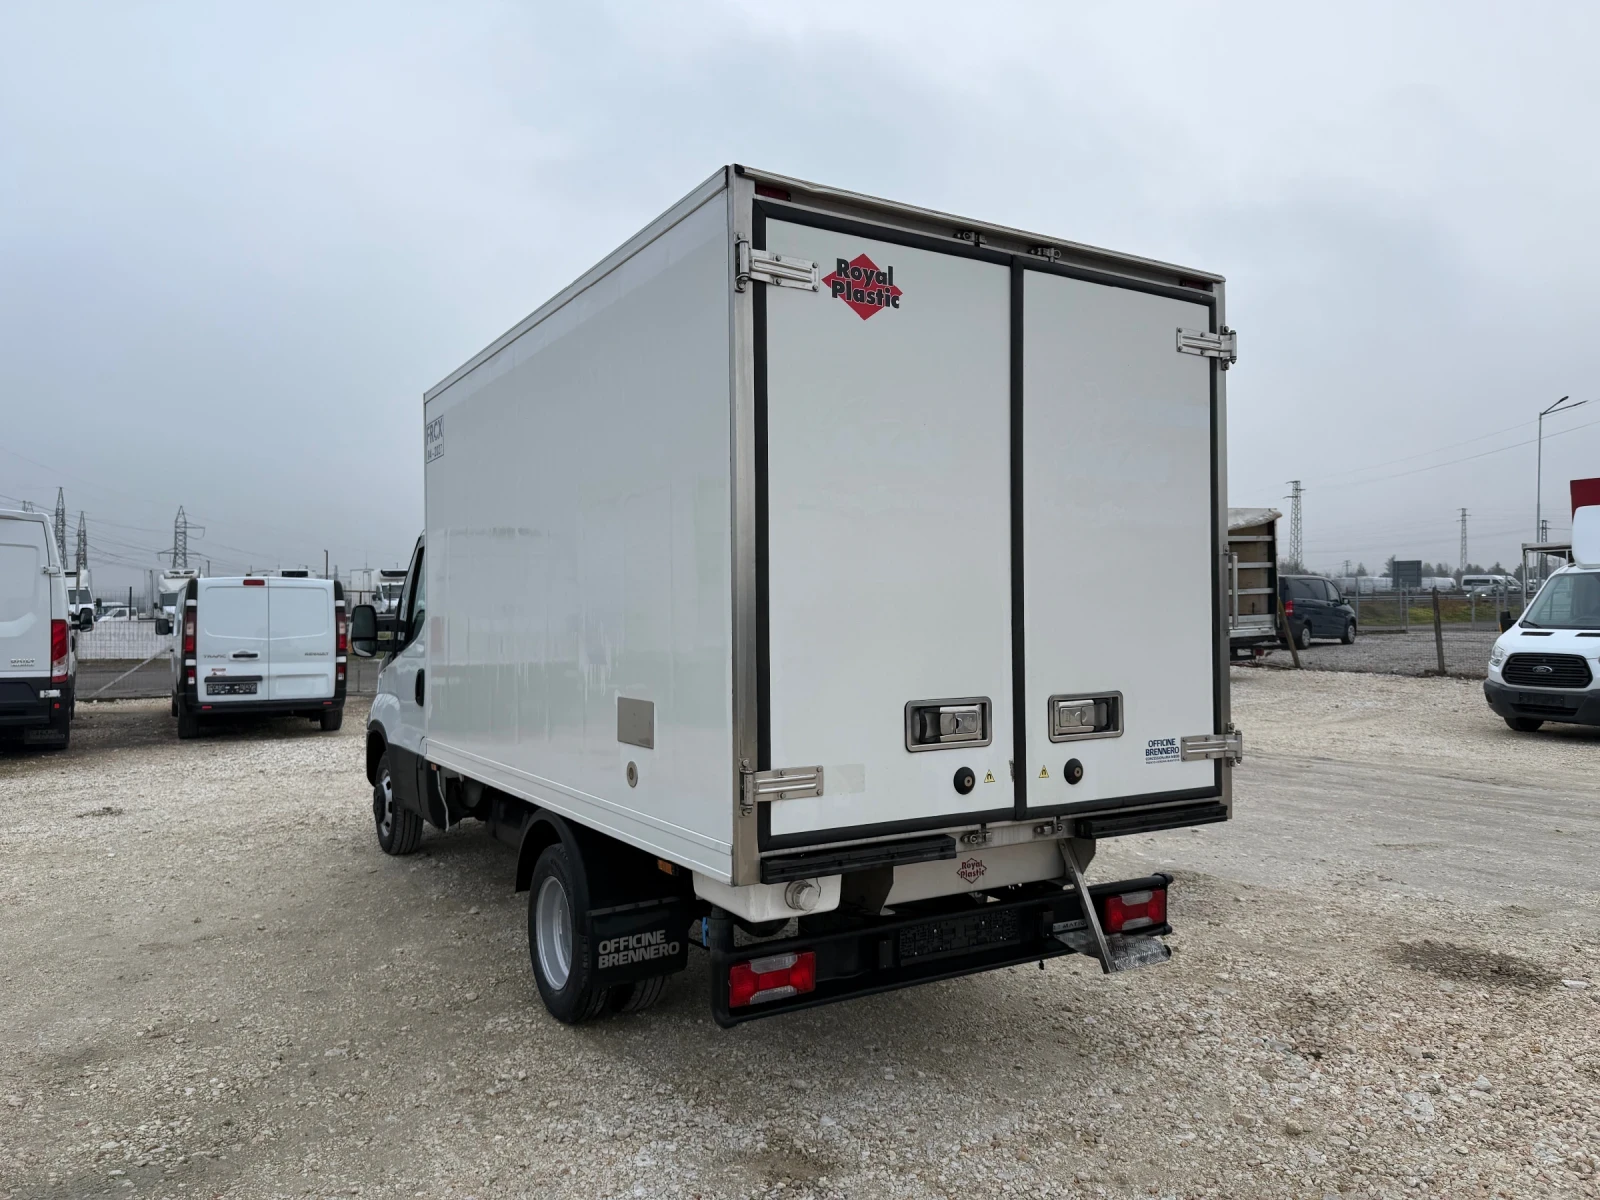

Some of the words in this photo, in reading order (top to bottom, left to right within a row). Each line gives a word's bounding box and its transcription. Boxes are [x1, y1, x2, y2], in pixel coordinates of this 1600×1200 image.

[836, 258, 893, 287] Royal
[831, 280, 900, 308] Plastic
[426, 418, 443, 446] FRCX
[1145, 746, 1179, 756] BRENNERO
[1148, 738, 1176, 747] OFFICINE
[960, 868, 985, 879] Plastic
[961, 860, 983, 870] Royal
[598, 929, 666, 955] OFFICINE
[598, 941, 680, 970] BRENNERO
